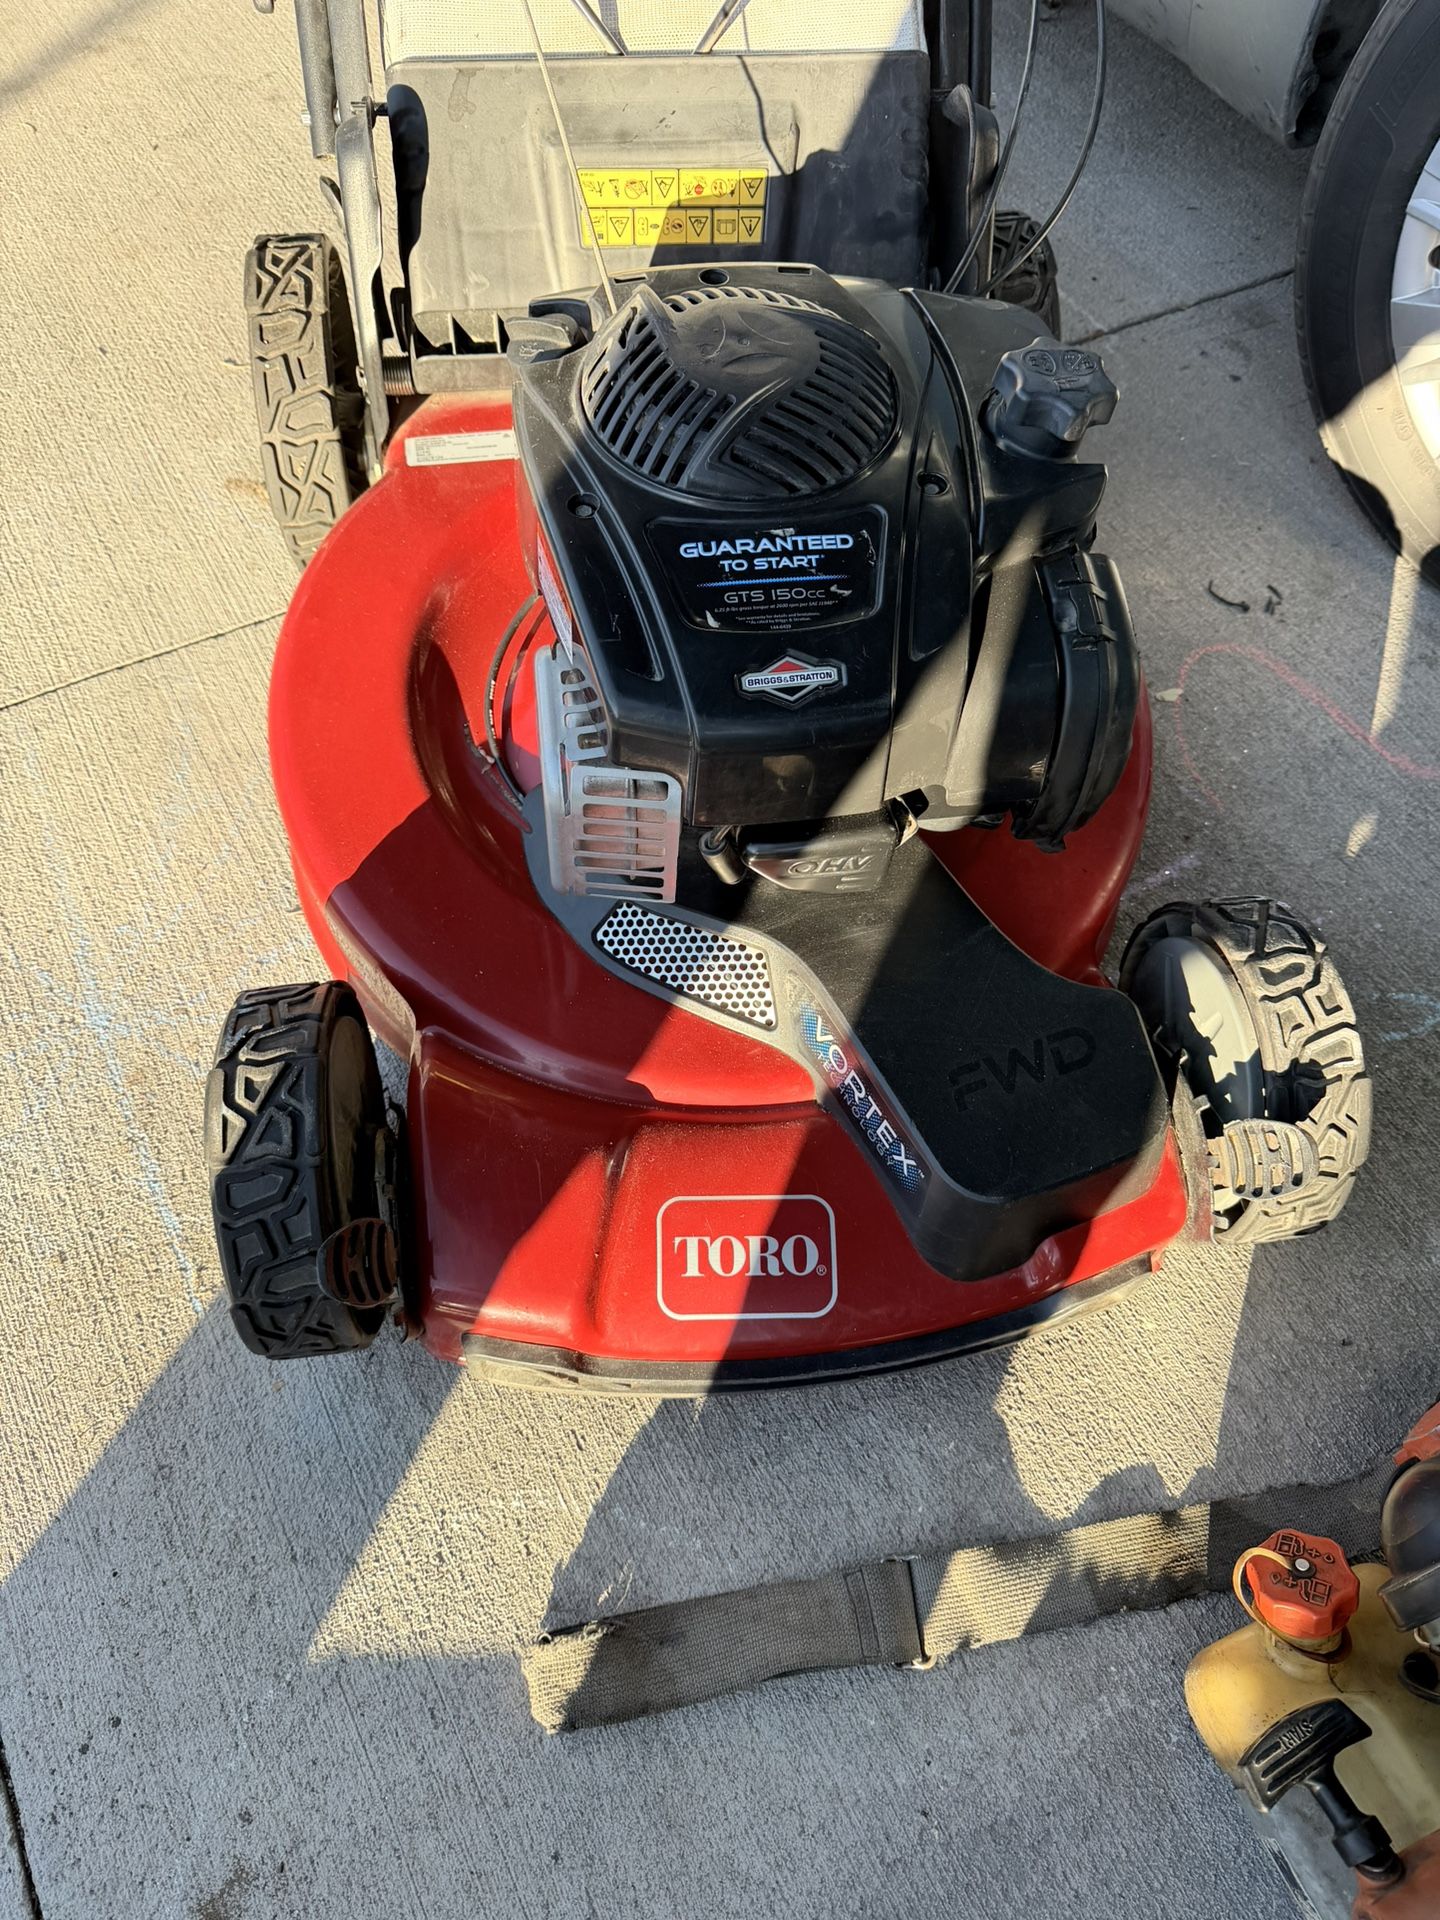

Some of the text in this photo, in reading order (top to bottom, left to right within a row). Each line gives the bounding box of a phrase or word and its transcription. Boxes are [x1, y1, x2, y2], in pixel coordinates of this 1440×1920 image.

[679, 534, 854, 558] GUARANTEED
[720, 558, 748, 572] TO
[724, 587, 826, 604] GTS 150cc
[788, 855, 876, 875] OHV
[947, 1026, 1097, 1112] FWD
[1278, 1719, 1314, 1754] START
